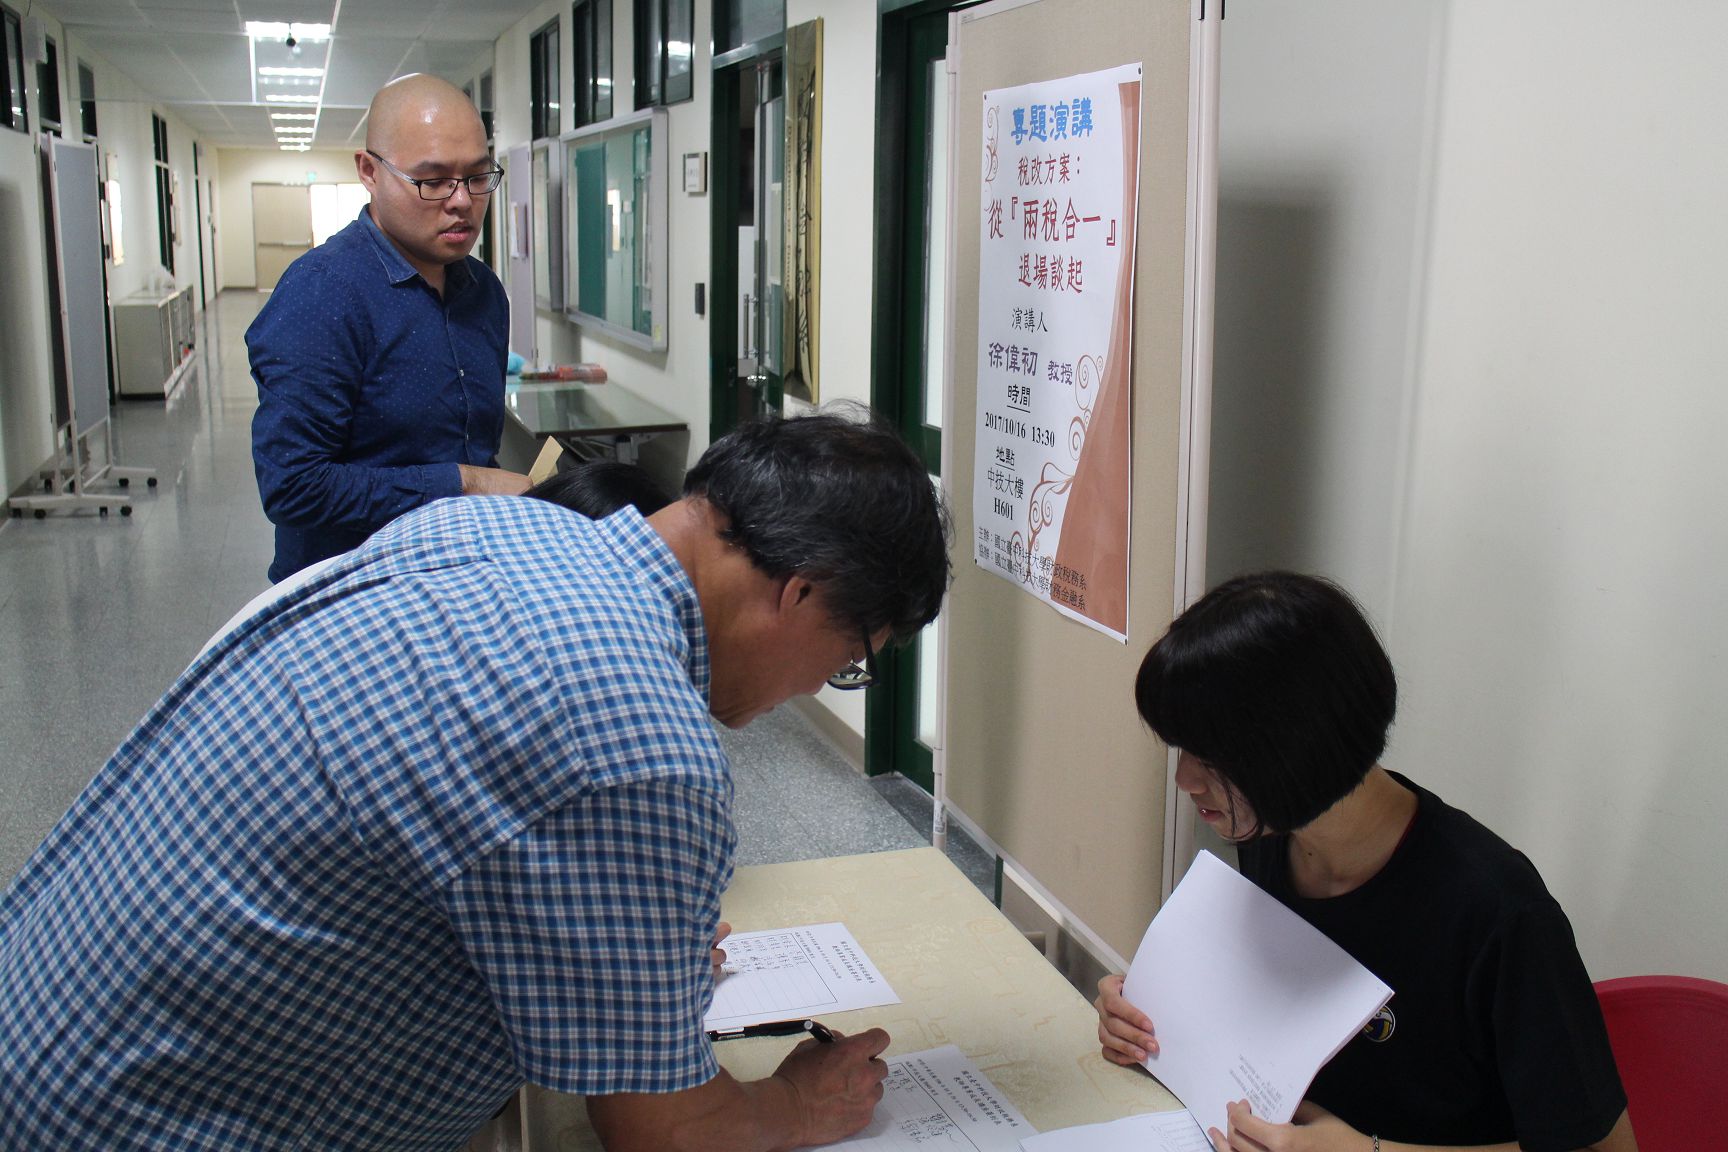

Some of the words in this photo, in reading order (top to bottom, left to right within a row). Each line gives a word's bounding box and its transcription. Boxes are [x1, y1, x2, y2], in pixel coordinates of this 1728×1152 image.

[1010, 97, 1093, 145] 專題演講
[1018, 253, 1083, 293] 退場談起
[1011, 307, 1048, 333] 演講人
[988, 342, 1038, 377] 徐偉初
[1047, 360, 1073, 386] 教授
[1007, 383, 1031, 407] 時間
[985, 412, 1026, 439] 2017/10/16
[1031, 427, 1055, 448] 13:30
[996, 446, 1015, 466] 地點
[987, 467, 1024, 500] 中技大樓
[994, 497, 1013, 521] H601
